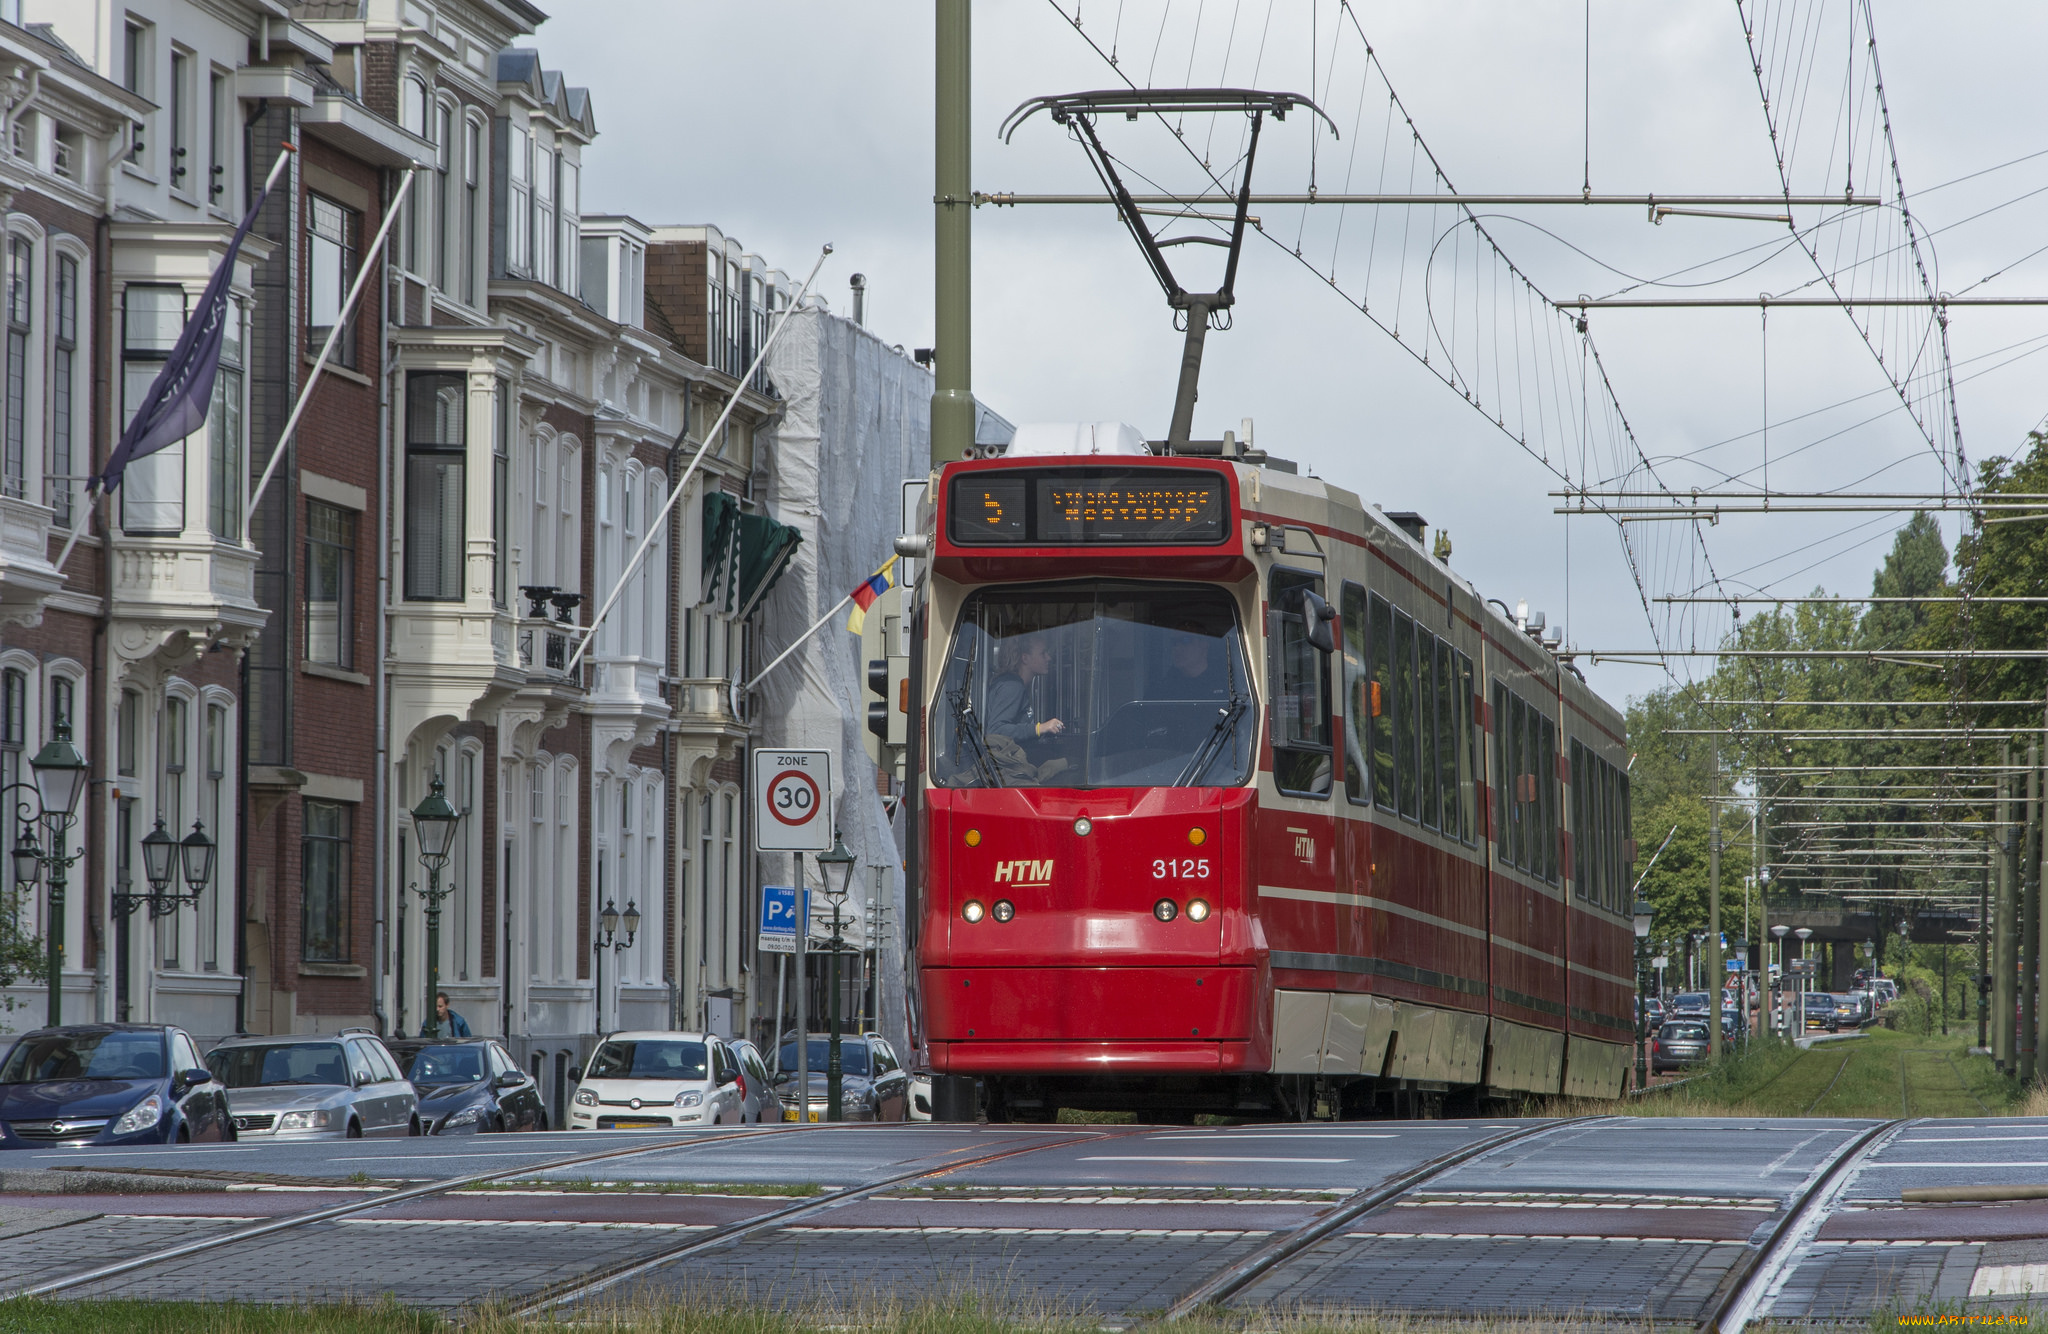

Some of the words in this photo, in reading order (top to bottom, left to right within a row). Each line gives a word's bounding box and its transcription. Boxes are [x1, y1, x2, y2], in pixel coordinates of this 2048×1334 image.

[777, 756, 808, 766] ZONE
[776, 786, 811, 809] 30
[1294, 835, 1315, 859] HTM
[994, 859, 1054, 883] HTM
[1152, 859, 1210, 879] 3125
[768, 900, 783, 920] P
